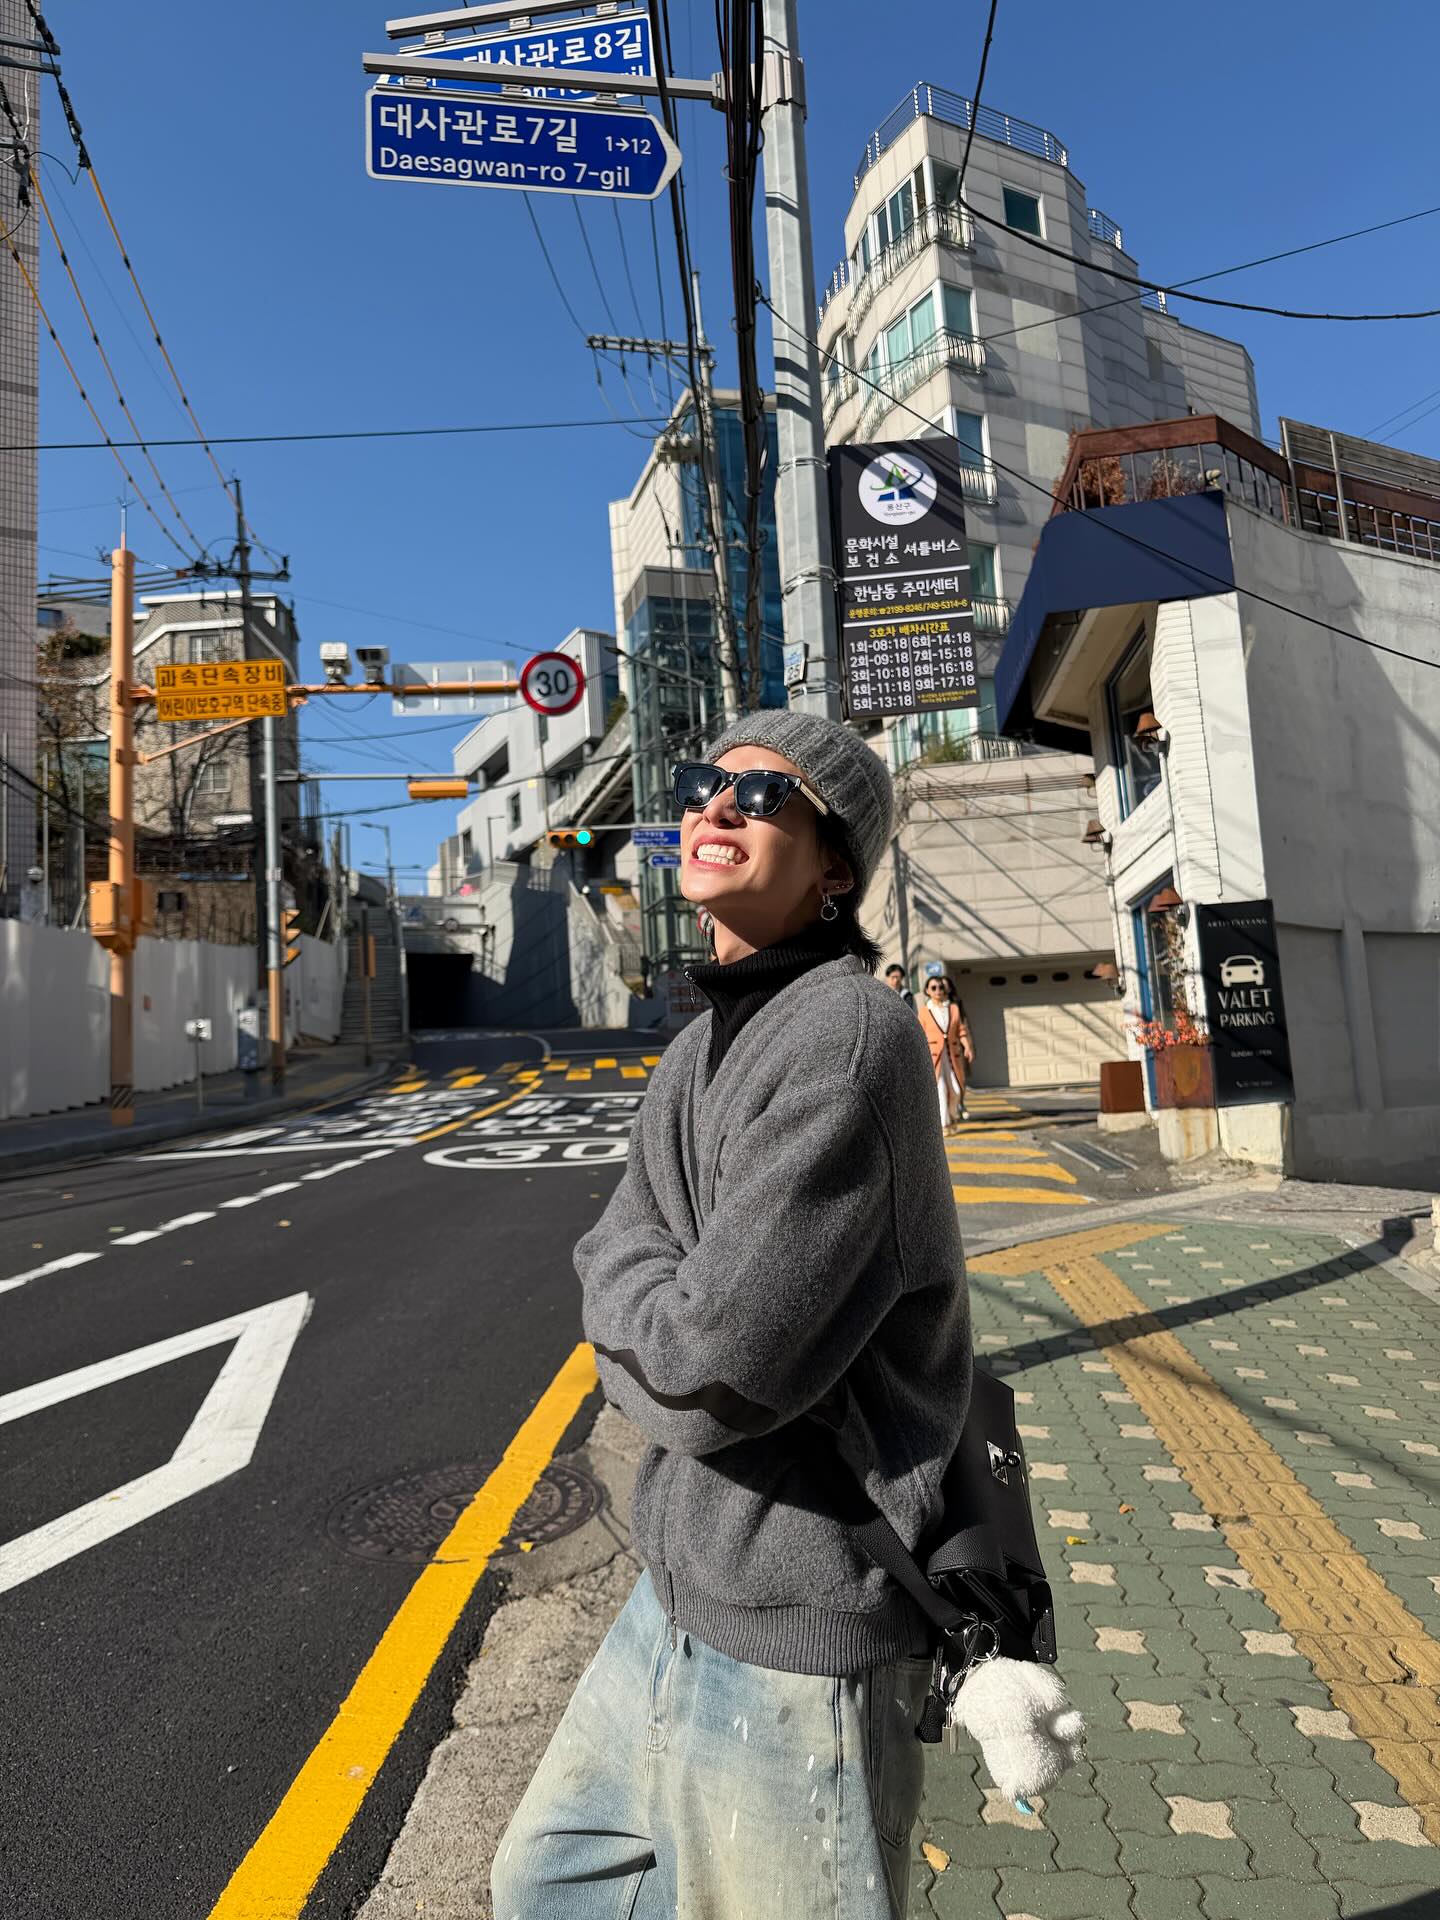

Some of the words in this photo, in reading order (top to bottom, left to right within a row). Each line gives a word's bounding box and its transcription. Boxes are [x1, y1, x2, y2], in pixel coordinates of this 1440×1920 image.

[379, 103, 578, 154] 대사관로7길
[379, 147, 566, 182] Daesagwan-ro
[573, 163, 631, 190] 7-gil
[844, 534, 899, 553] 문화시설
[903, 539, 961, 557] 셔틀버스
[854, 582, 898, 603] 한남동
[901, 576, 959, 598] 주민센터
[899, 622, 950, 636] 배차시간표
[536, 669, 569, 697] 30
[160, 694, 245, 717] 어린이보호구역
[247, 693, 282, 712] 단속중
[1218, 988, 1272, 1009] VALET
[1220, 1011, 1276, 1028] PARKING
[466, 1141, 629, 1164] 30
